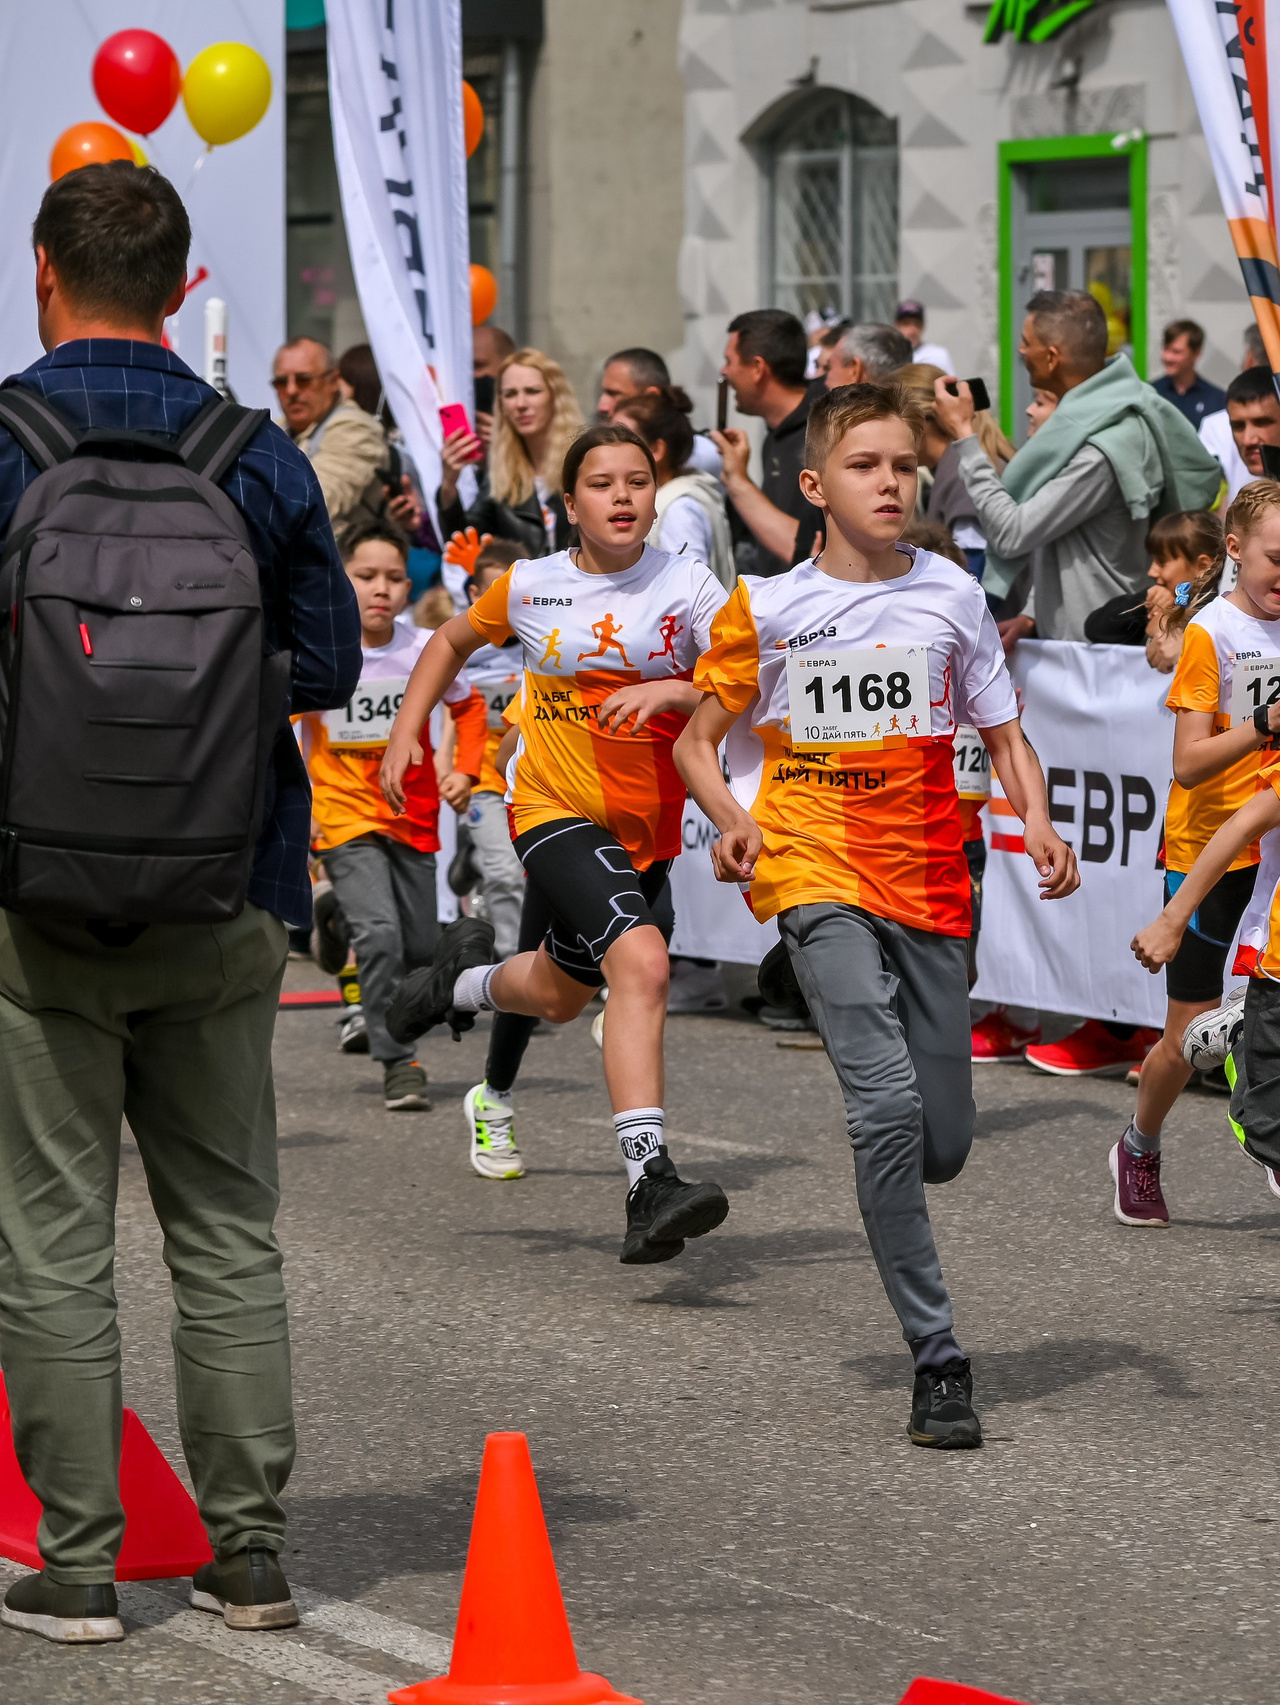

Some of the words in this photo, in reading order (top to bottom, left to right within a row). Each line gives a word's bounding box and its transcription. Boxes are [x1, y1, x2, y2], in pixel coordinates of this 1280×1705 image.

[533, 597, 573, 607] ЕВРАЗ
[789, 626, 837, 648] ЕВРАЗ
[1236, 651, 1262, 661] ЕВРАЗ
[805, 671, 912, 714] 1168
[566, 704, 601, 721] ПЯТ
[804, 726, 820, 740] 10
[822, 731, 842, 740] ДАЙ
[843, 730, 867, 739] ПЯТЬ
[771, 763, 811, 784] ДАЙ
[817, 770, 887, 790] ПЯТЬ!
[1047, 767, 1172, 870] ЕВР
[682, 818, 721, 850] СМ
[622, 1133, 657, 1160] FRESH
